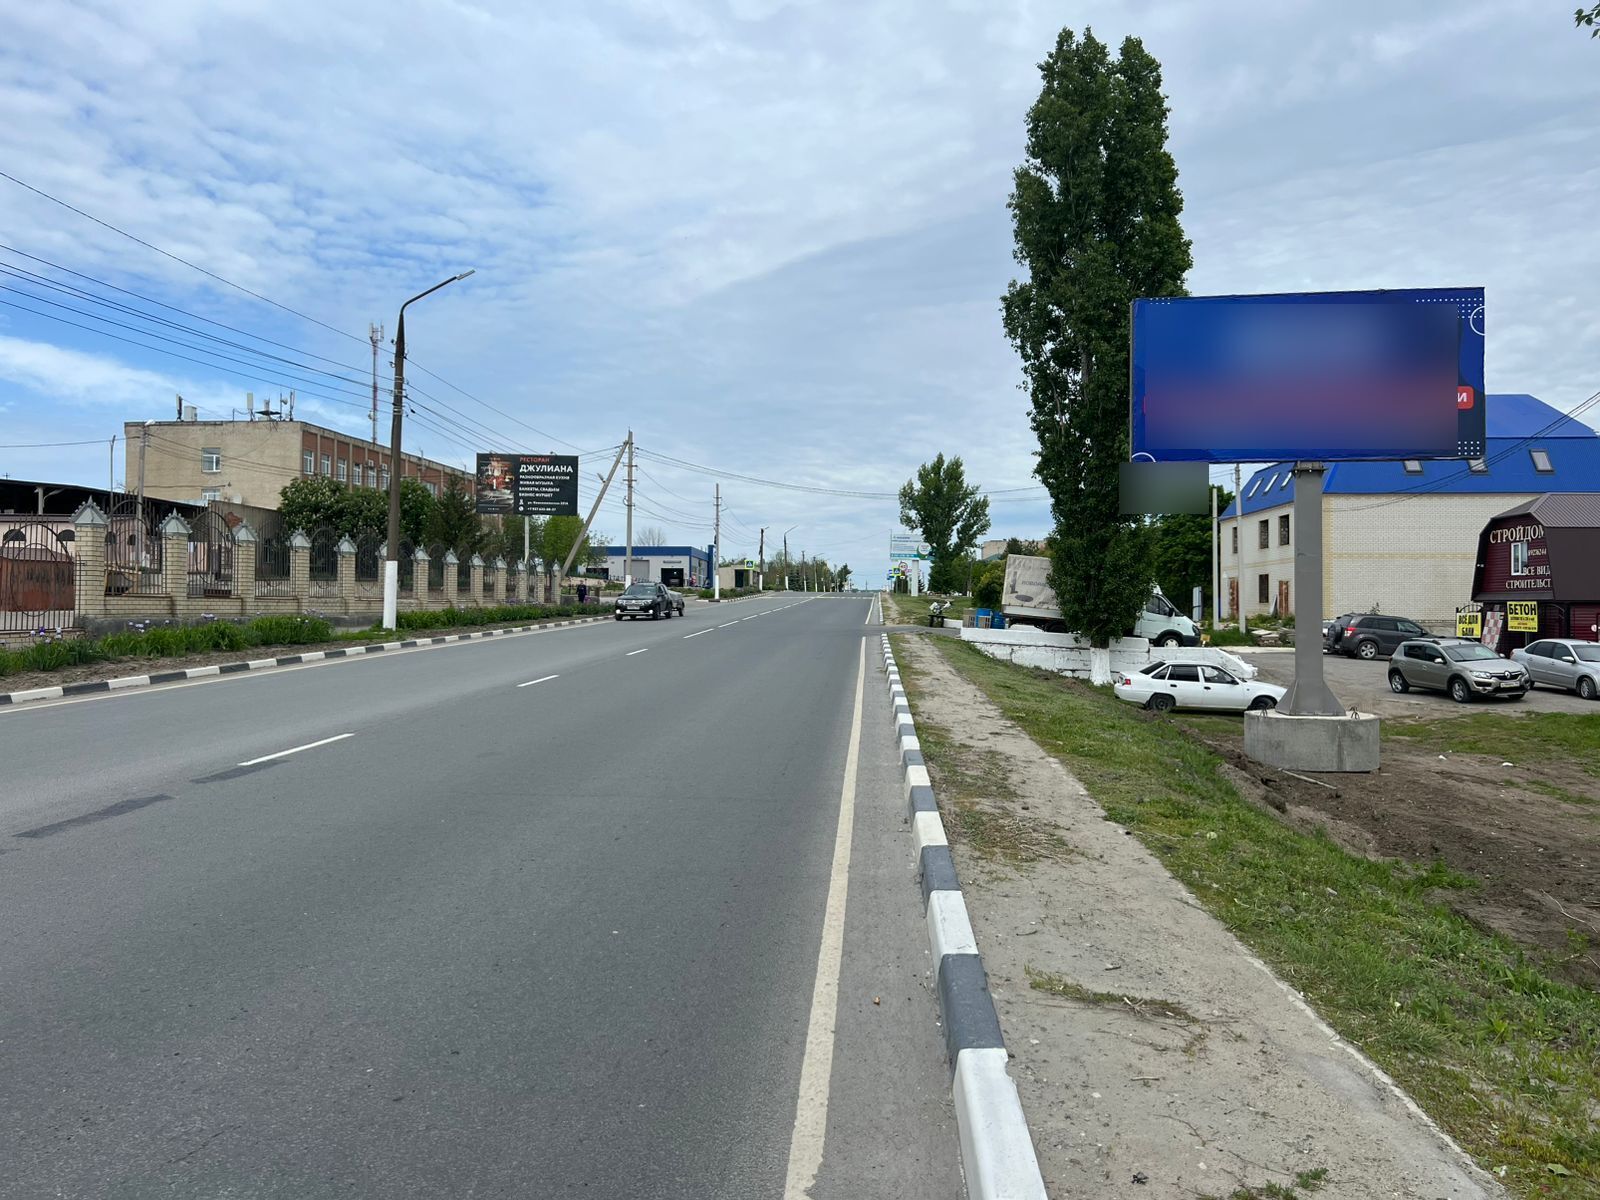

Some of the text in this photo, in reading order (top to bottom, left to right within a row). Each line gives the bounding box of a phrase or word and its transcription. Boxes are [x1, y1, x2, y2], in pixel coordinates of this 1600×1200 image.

[519, 464, 574, 473] ДЖУЛИАНА
[1522, 566, 1535, 576] ВСЕ
[1508, 603, 1537, 615] БЕТОН
